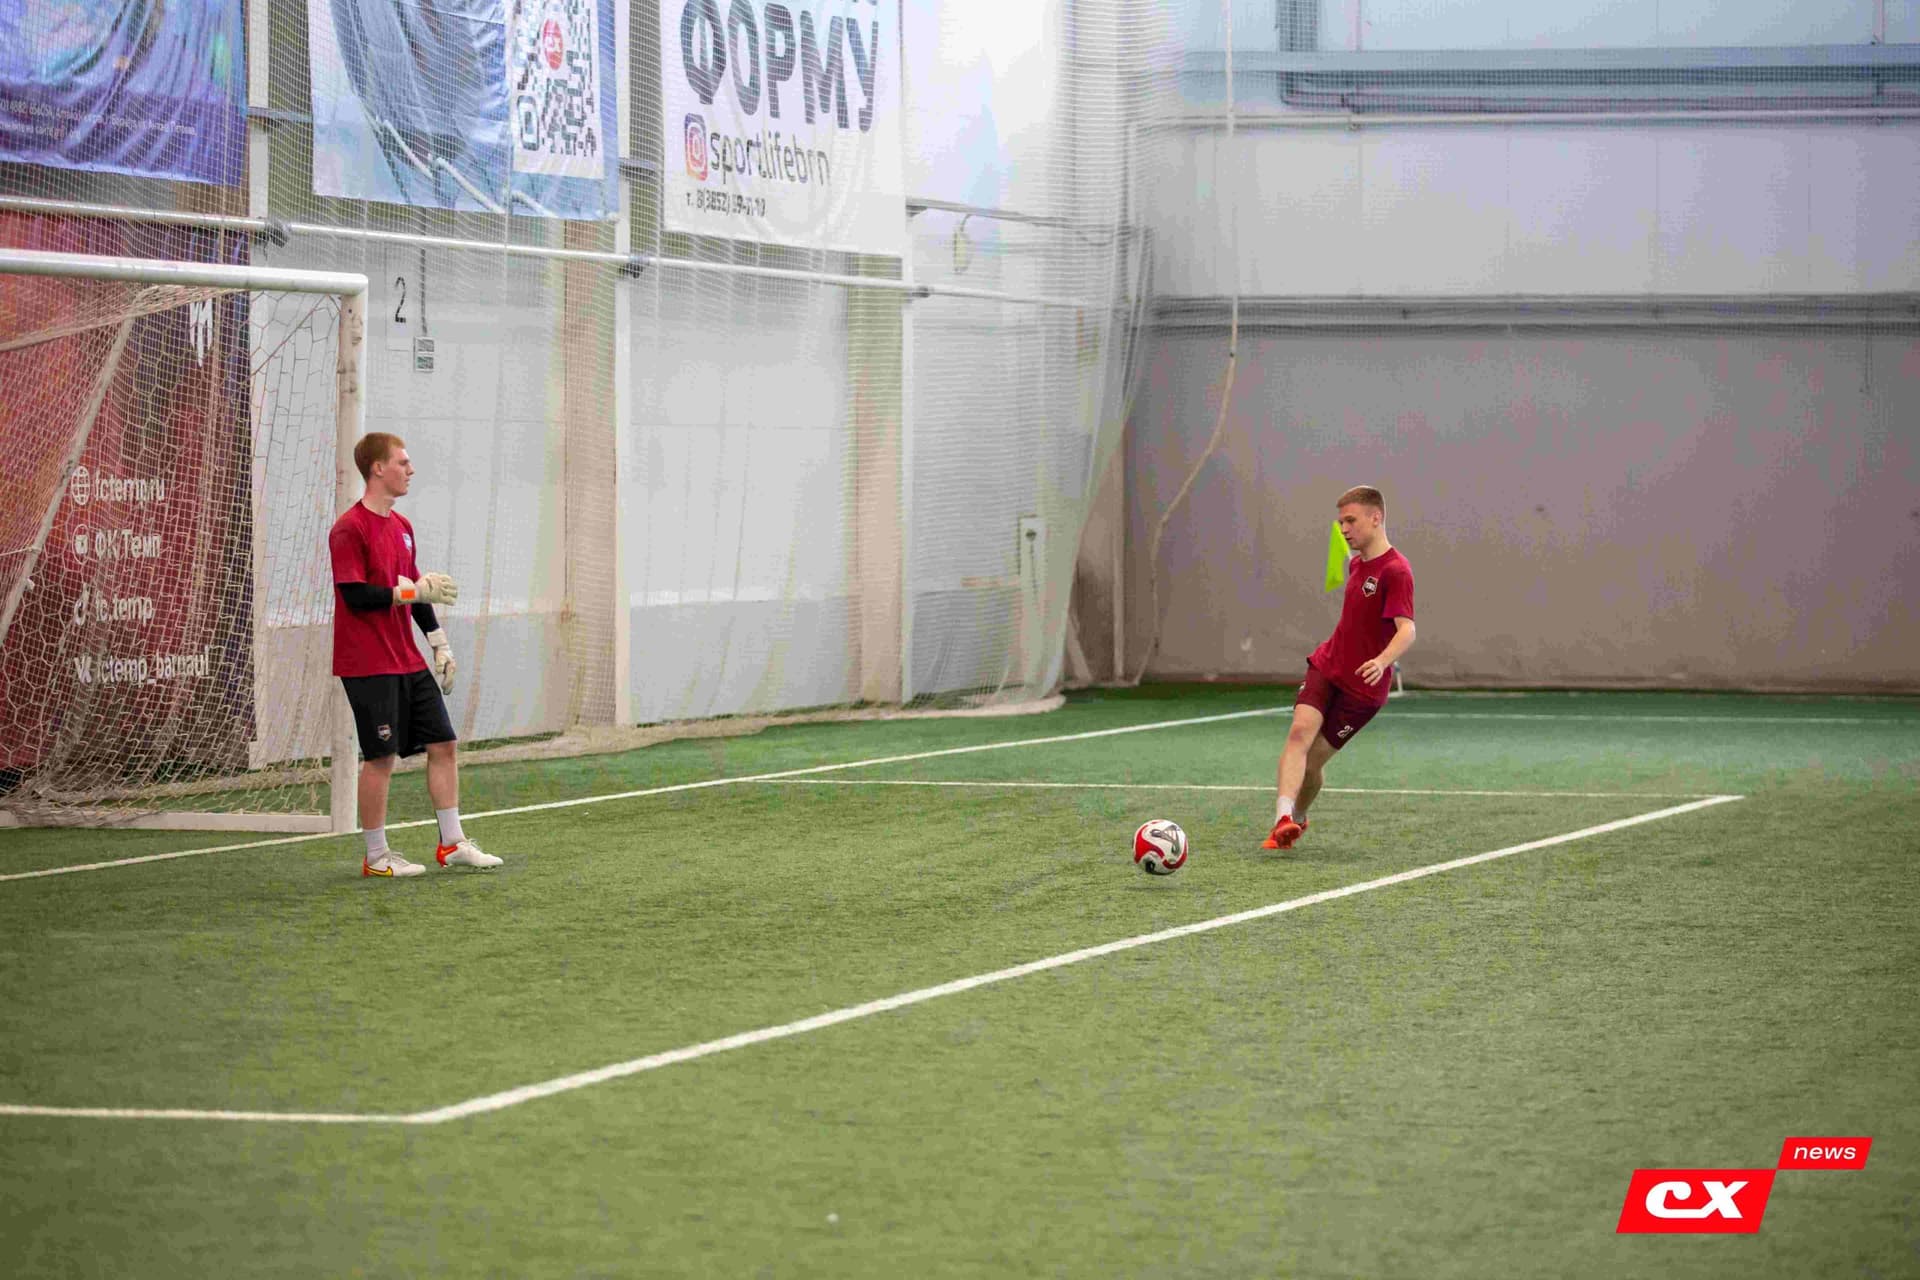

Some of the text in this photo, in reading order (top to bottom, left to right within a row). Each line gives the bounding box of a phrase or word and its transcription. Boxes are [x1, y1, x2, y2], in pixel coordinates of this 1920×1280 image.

[680, 0, 879, 133] ФОРМУ
[710, 129, 832, 187] sportlifebrn
[394, 276, 407, 323] 2
[120, 528, 161, 558] Темп
